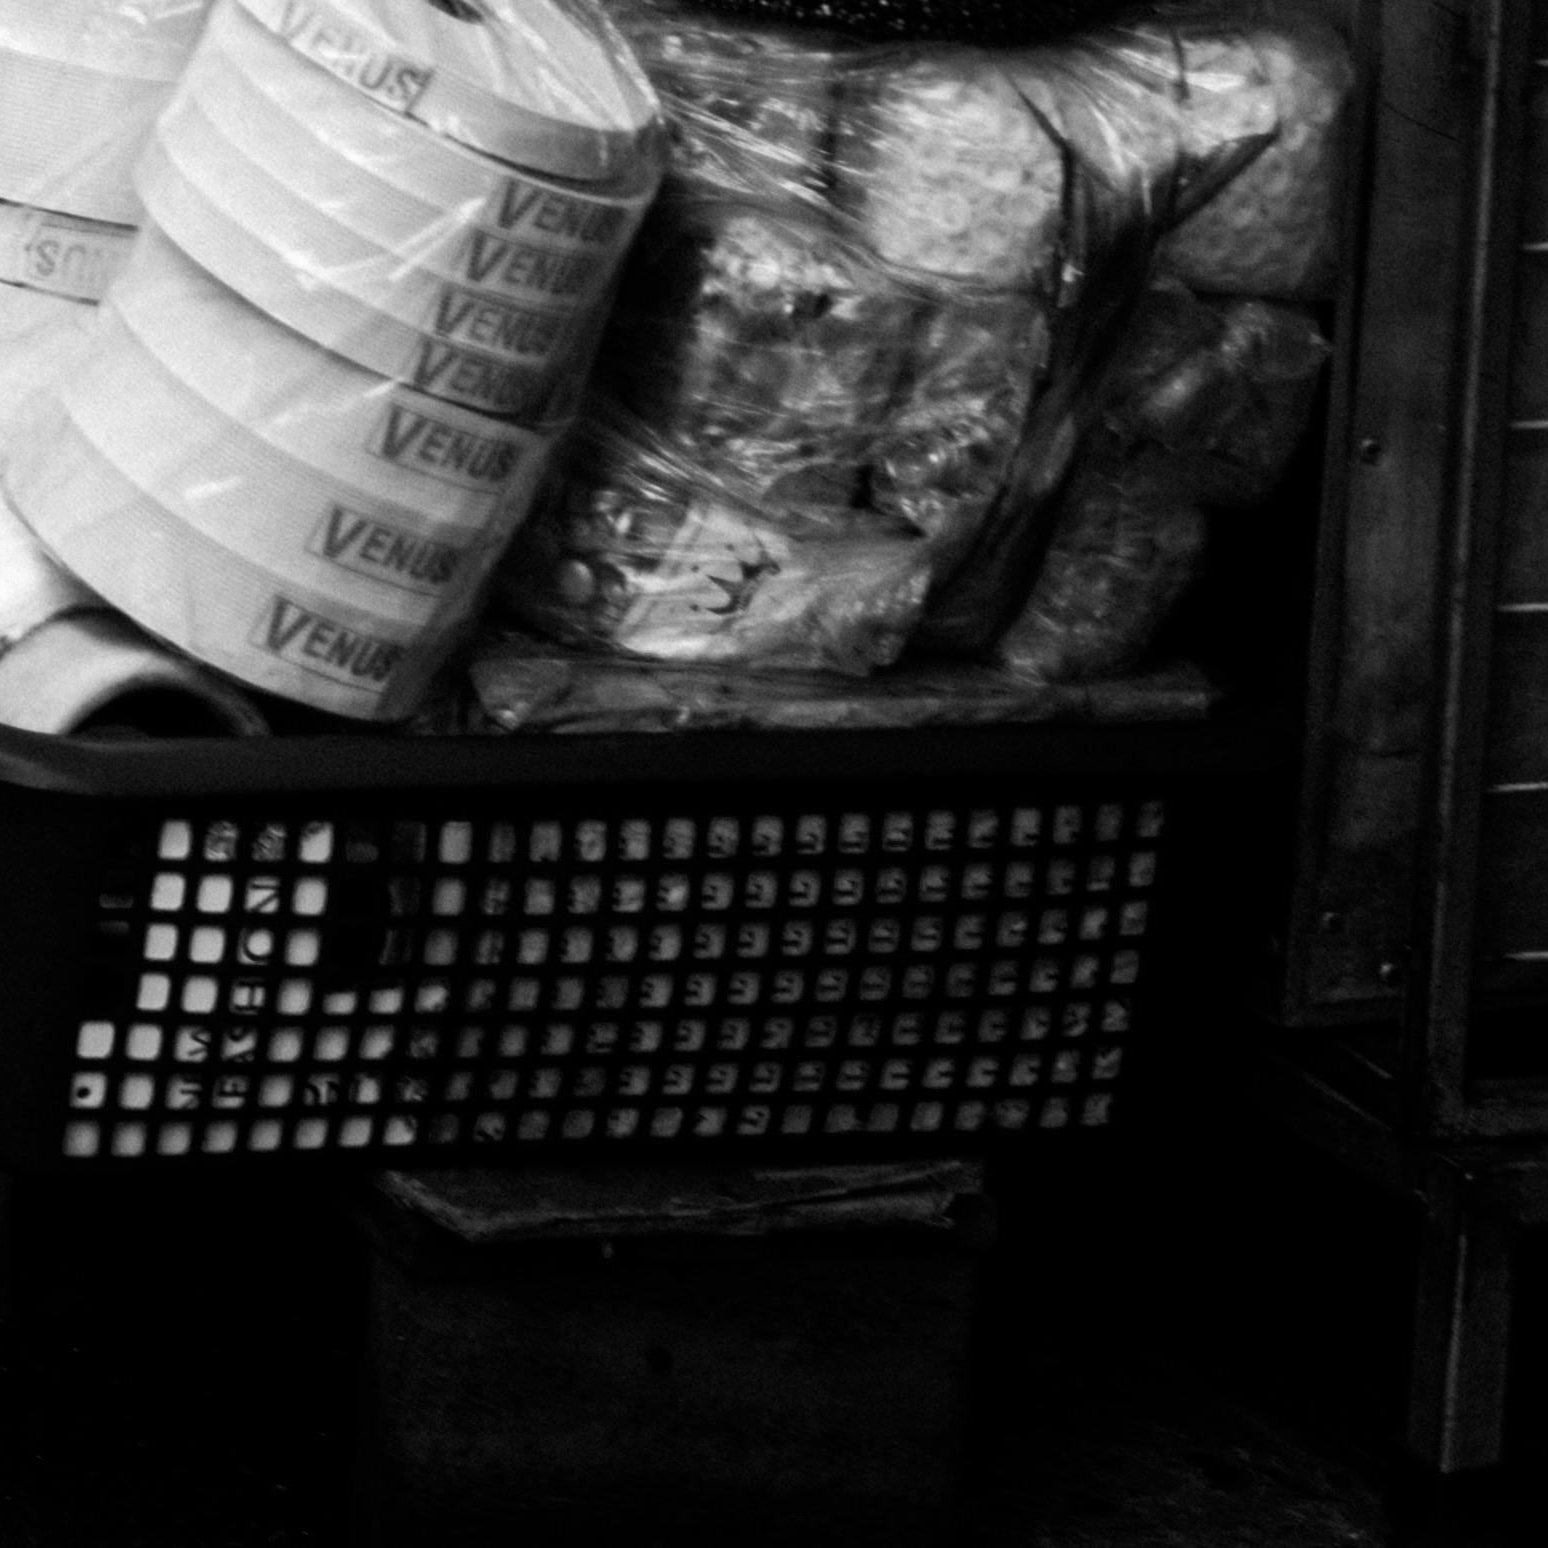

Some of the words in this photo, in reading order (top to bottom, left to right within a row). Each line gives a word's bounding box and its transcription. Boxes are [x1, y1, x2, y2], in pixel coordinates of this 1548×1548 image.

[381, 405, 520, 483] VENUS
[323, 506, 465, 584] VENUS
[265, 594, 408, 682] VENUS
